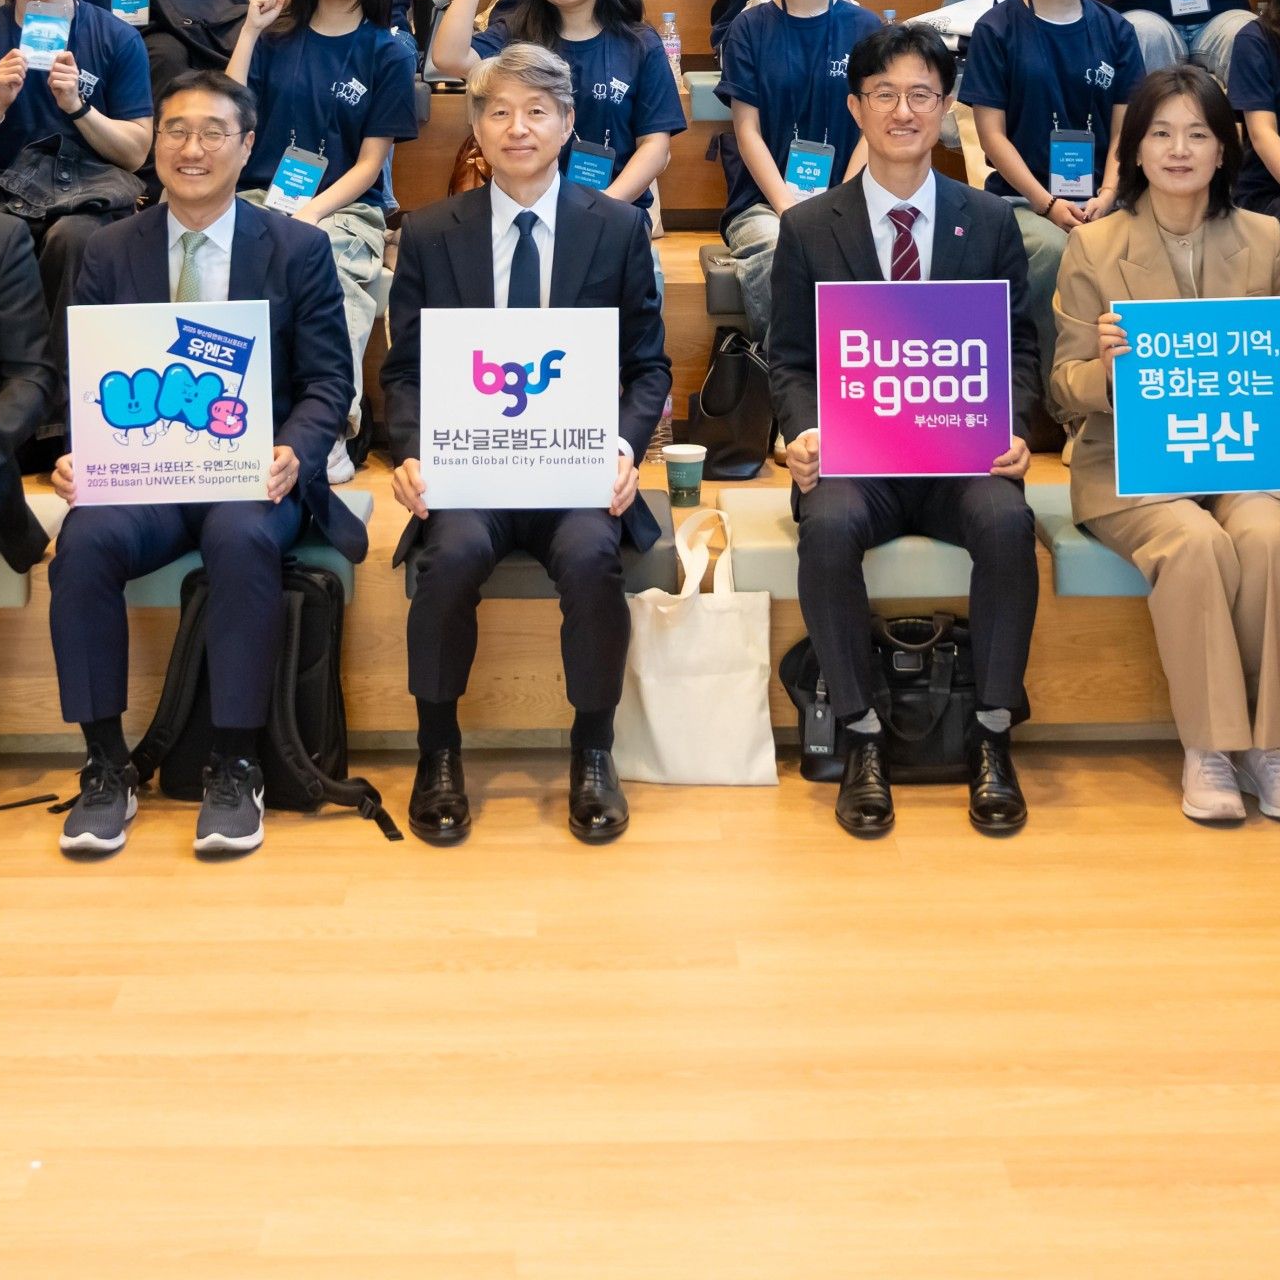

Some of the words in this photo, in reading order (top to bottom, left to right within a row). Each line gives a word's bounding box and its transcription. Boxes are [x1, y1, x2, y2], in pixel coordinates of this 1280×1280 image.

[187, 338, 236, 366] 유엔즈
[840, 330, 987, 368] Busan
[1136, 332, 1218, 359] 80년의
[1227, 330, 1279, 357] 기억,
[840, 376, 865, 399] is
[873, 368, 988, 416] good
[1139, 367, 1220, 399] 평화로
[1228, 370, 1273, 396] 잇는
[914, 414, 961, 427] 부산이라
[964, 414, 988, 427] 좋다
[433, 429, 606, 450] 부산글로벌도시재단
[1166, 411, 1259, 463] 부산
[87, 464, 106, 475] 부산
[110, 462, 150, 474] 유엔위크
[153, 461, 193, 473] 서포터즈
[434, 456, 468, 465] Busan
[472, 456, 508, 465] Global
[513, 456, 535, 466] City
[540, 455, 604, 464] Foundation
[88, 478, 108, 487] 2025
[111, 477, 142, 487] Busan
[146, 476, 195, 486] UNWEEK
[199, 475, 259, 485] Supporters
